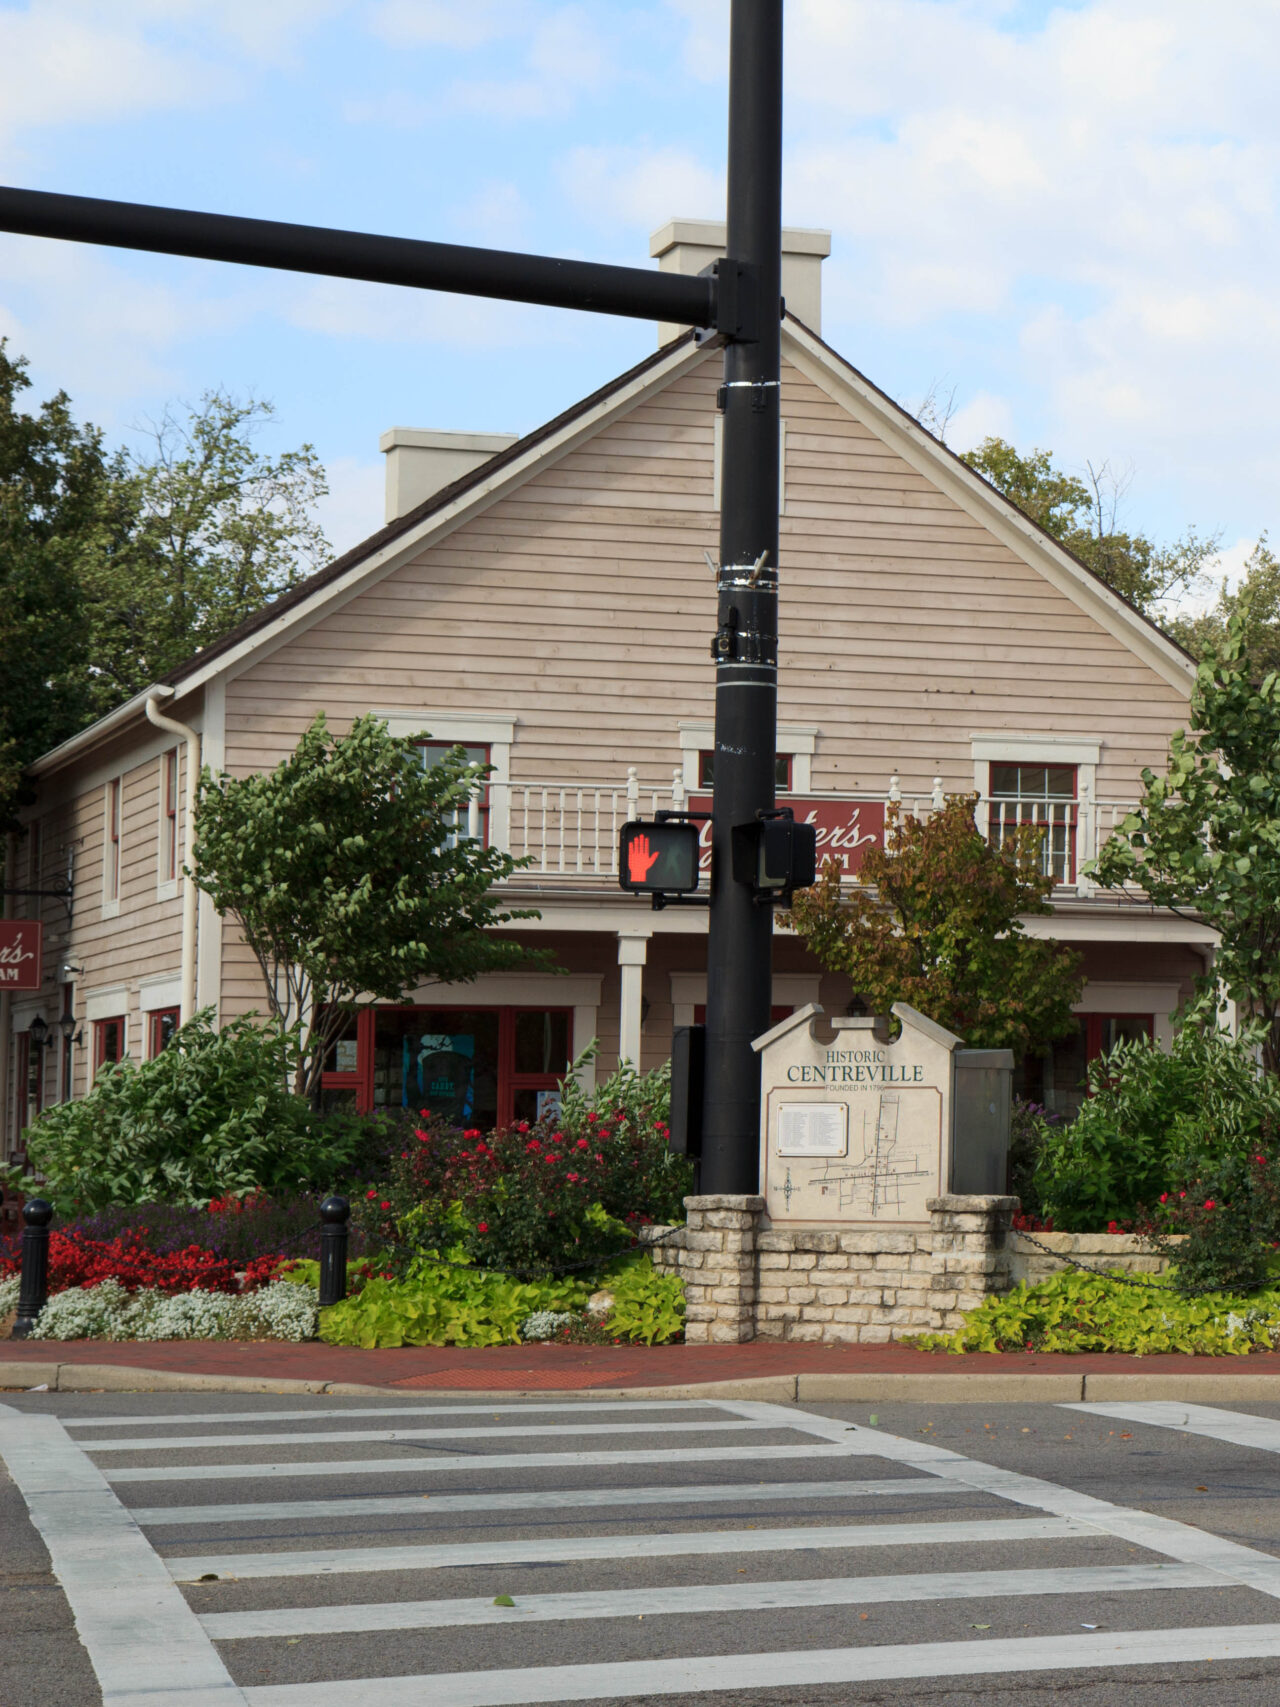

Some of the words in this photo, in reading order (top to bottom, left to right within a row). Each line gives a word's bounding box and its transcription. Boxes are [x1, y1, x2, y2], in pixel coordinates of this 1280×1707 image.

[826, 1050, 885, 1063] HISTORIC
[787, 1065, 924, 1082] CENTREVILLE
[825, 1084, 859, 1092] FOUNDED
[860, 1084, 868, 1092] IN
